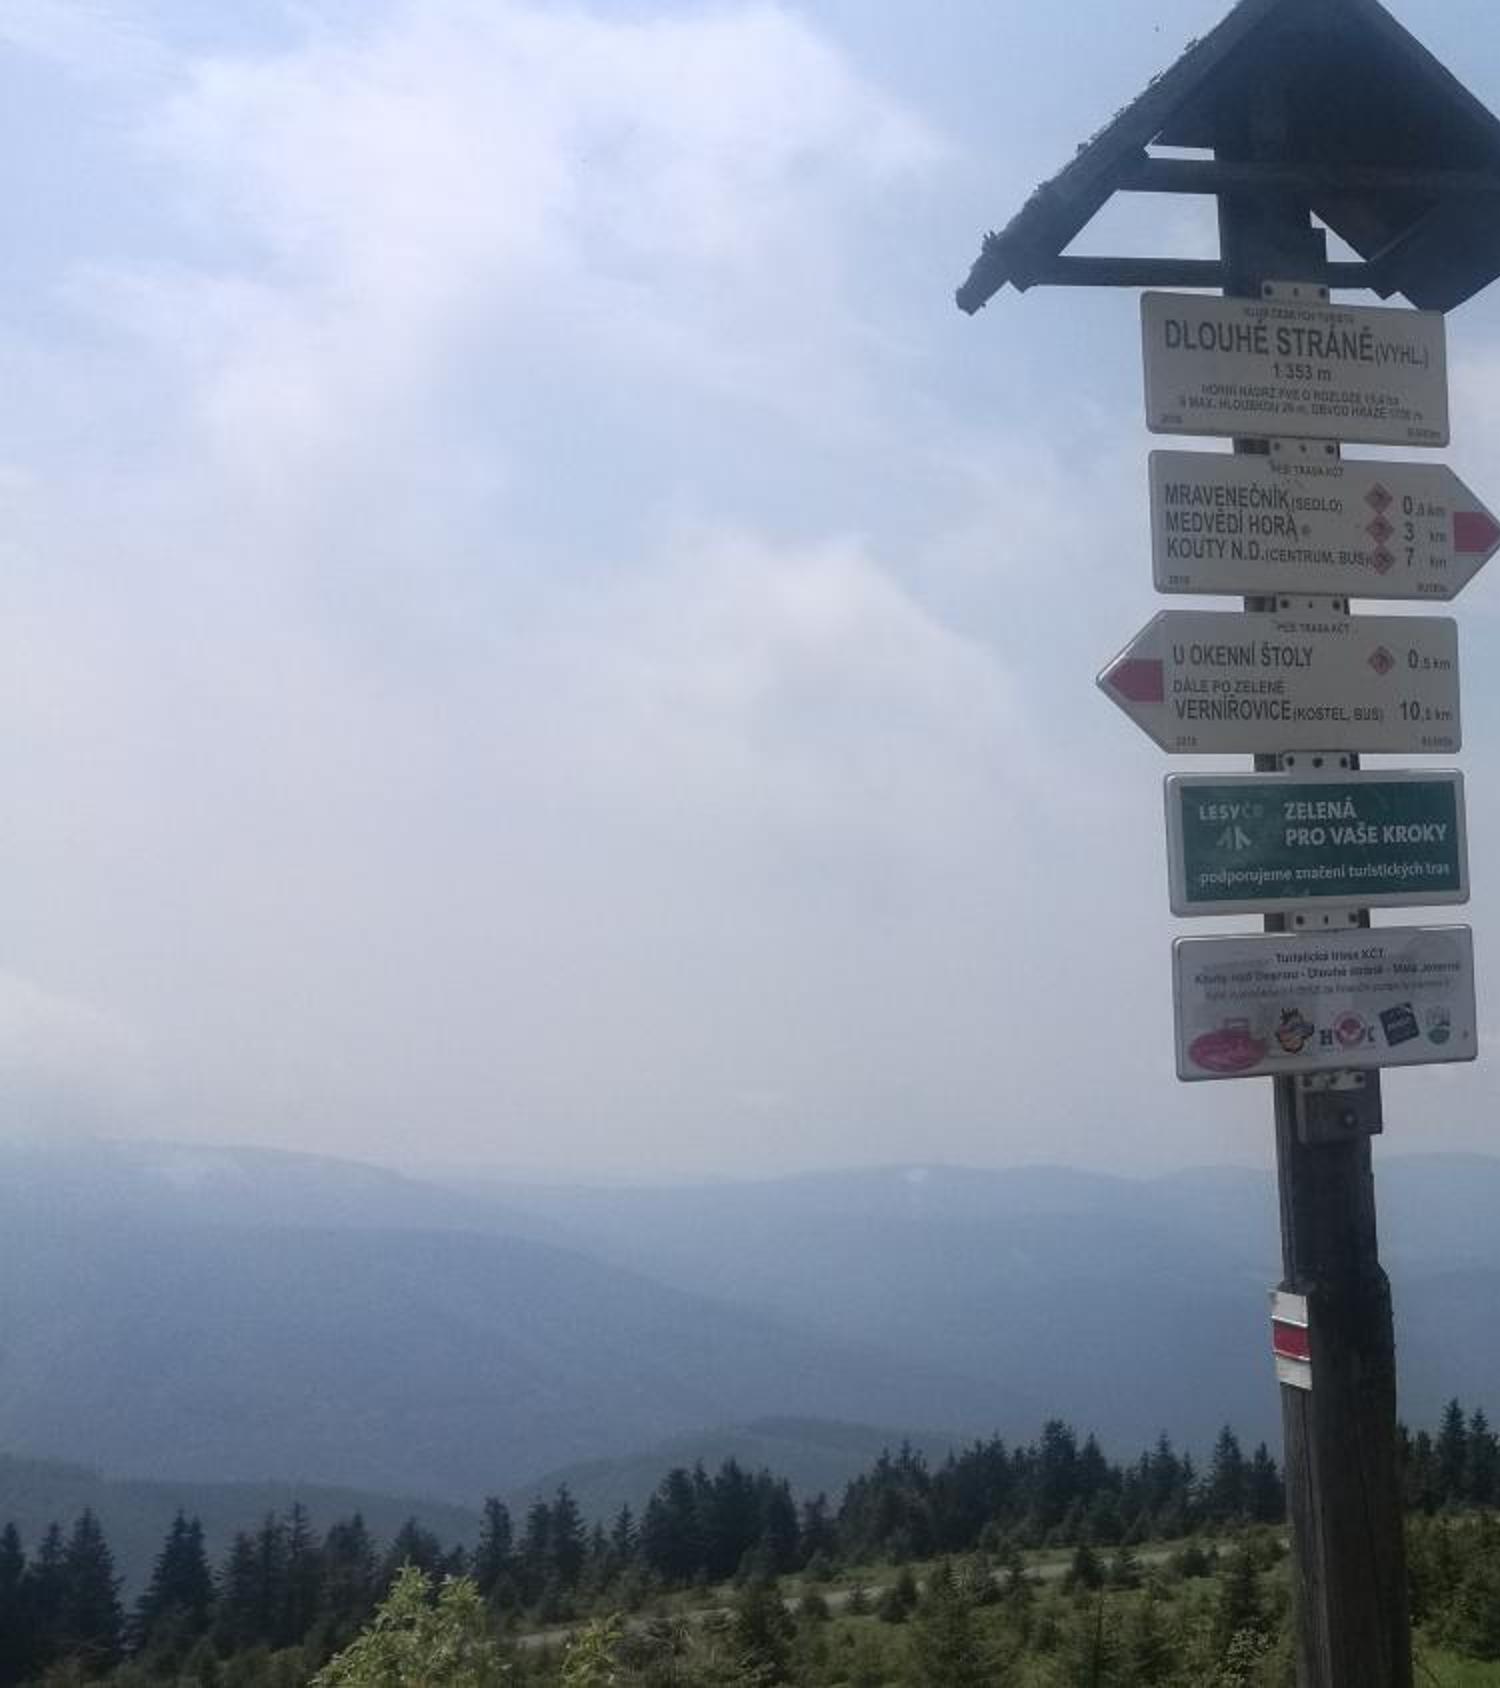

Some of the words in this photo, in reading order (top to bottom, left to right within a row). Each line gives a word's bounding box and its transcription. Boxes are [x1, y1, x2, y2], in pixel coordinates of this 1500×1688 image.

[1165, 319, 1269, 355] DLOUHÉ
[1165, 483, 1289, 508] MRAVENEČNÍK
[1166, 509, 1243, 534] MEDVĚDÍ
[1404, 521, 1414, 541] 3
[1167, 538, 1226, 560] KOUTY
[1231, 540, 1264, 561] N.D.
[1404, 546, 1414, 566] 7
[1173, 644, 1184, 666] U
[1190, 640, 1255, 667] OKENNÍ
[1261, 641, 1312, 667] ŠTOLY
[1175, 694, 1291, 720] VERNÍŘOVICE
[1284, 795, 1358, 821] ZELENÁ
[1285, 827, 1325, 846] PRO
[1330, 821, 1378, 845] VAŠE
[1383, 823, 1447, 844] KROKY
[1200, 868, 1293, 889] podporujeme
[1296, 863, 1345, 881] značení
[1349, 861, 1423, 880] turistických
